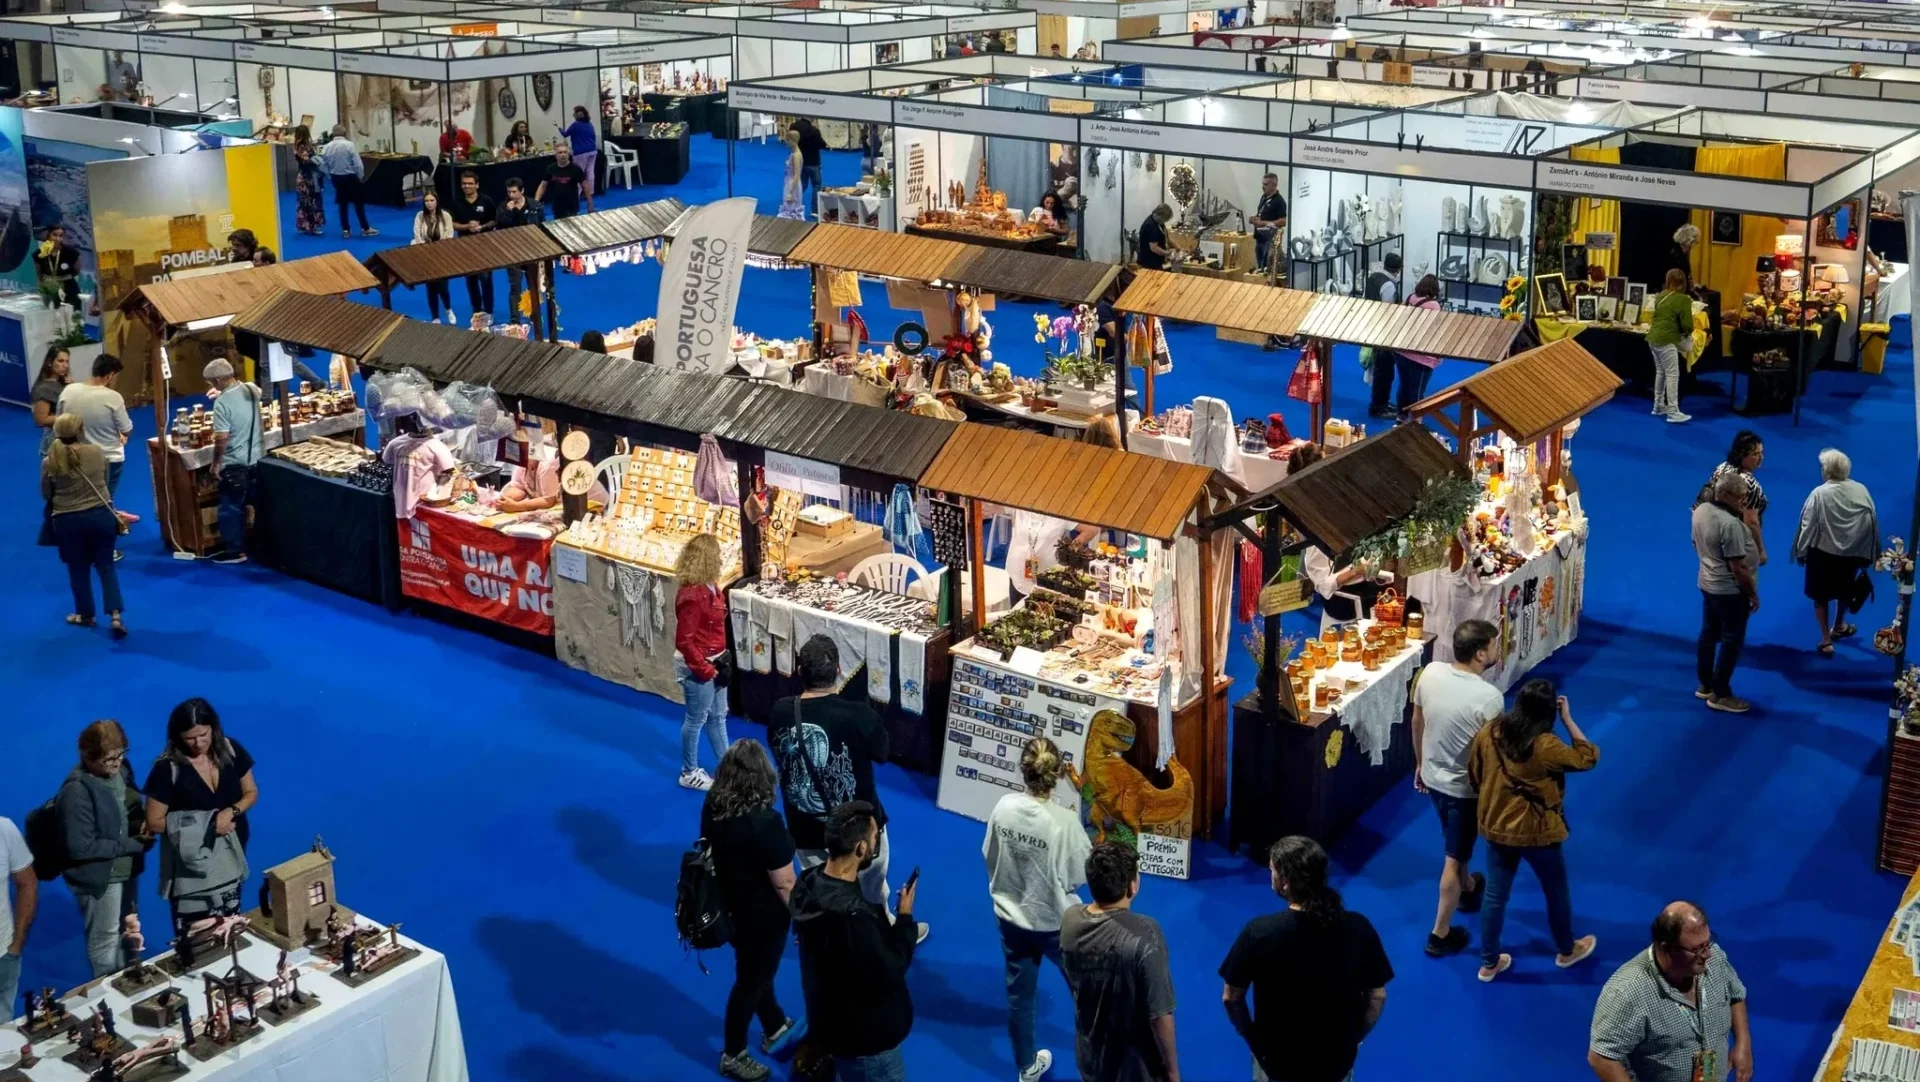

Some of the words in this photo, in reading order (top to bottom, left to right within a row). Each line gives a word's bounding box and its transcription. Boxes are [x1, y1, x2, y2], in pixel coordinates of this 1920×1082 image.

[808, 97, 826, 105] Portugal
[1317, 145, 1334, 153] André
[1334, 146, 1354, 156] Soares
[1354, 148, 1368, 156] Prior
[1549, 166, 1578, 176] ZemiArt's
[1610, 172, 1634, 182] Miranda
[1640, 175, 1656, 184] José
[1656, 178, 1676, 186] Neves
[1572, 182, 1594, 190] CASTELO
[161, 249, 226, 270] POMBAL
[700, 238, 728, 324] CANCRO
[676, 236, 708, 370] PORTUGUESA
[697, 328, 714, 347] O
[460, 544, 518, 580] UMA
[464, 572, 511, 606] QUE
[1140, 852, 1164, 862] RIFAS
[1166, 858, 1184, 866] COM
[1140, 862, 1184, 876] CATEGORIA
